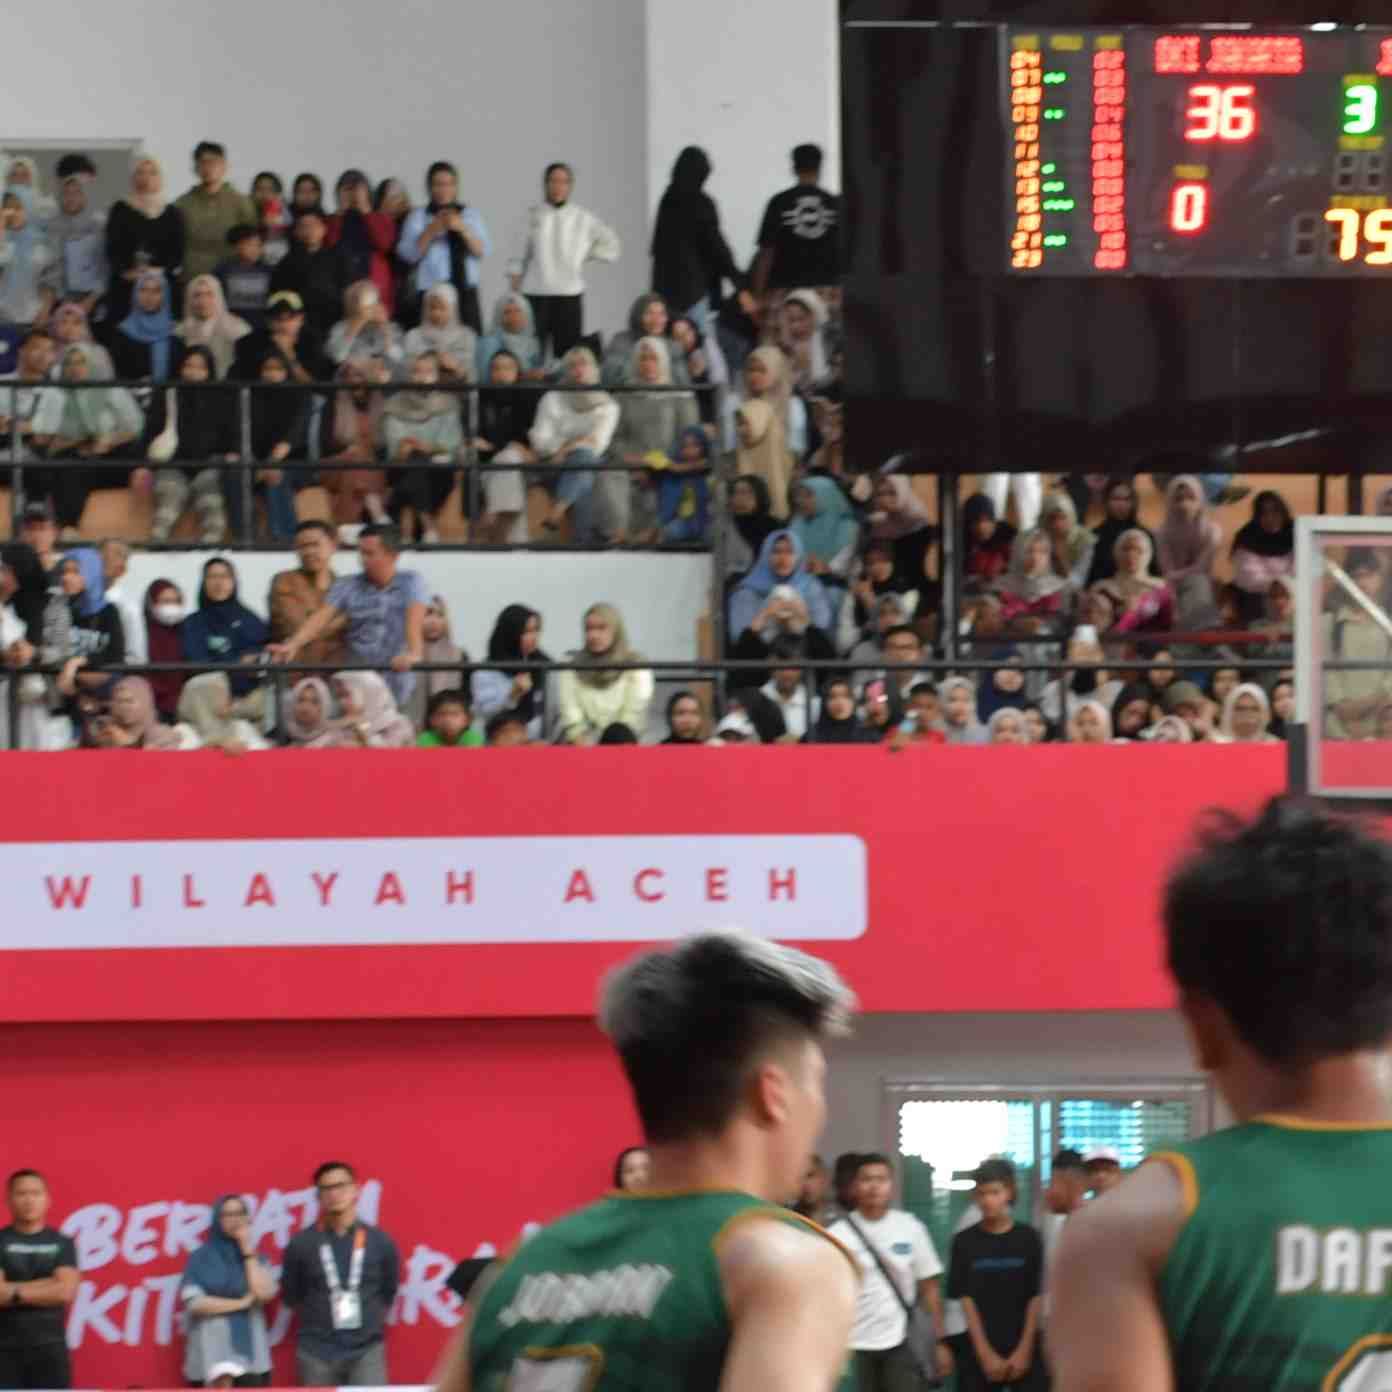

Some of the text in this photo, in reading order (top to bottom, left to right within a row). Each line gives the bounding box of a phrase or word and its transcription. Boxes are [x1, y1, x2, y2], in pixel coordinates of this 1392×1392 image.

[1183, 84, 1257, 140] 36
[1343, 84, 1379, 133] 3
[1169, 184, 1208, 232] 0
[43, 866, 799, 911] WILAYAH ACEH
